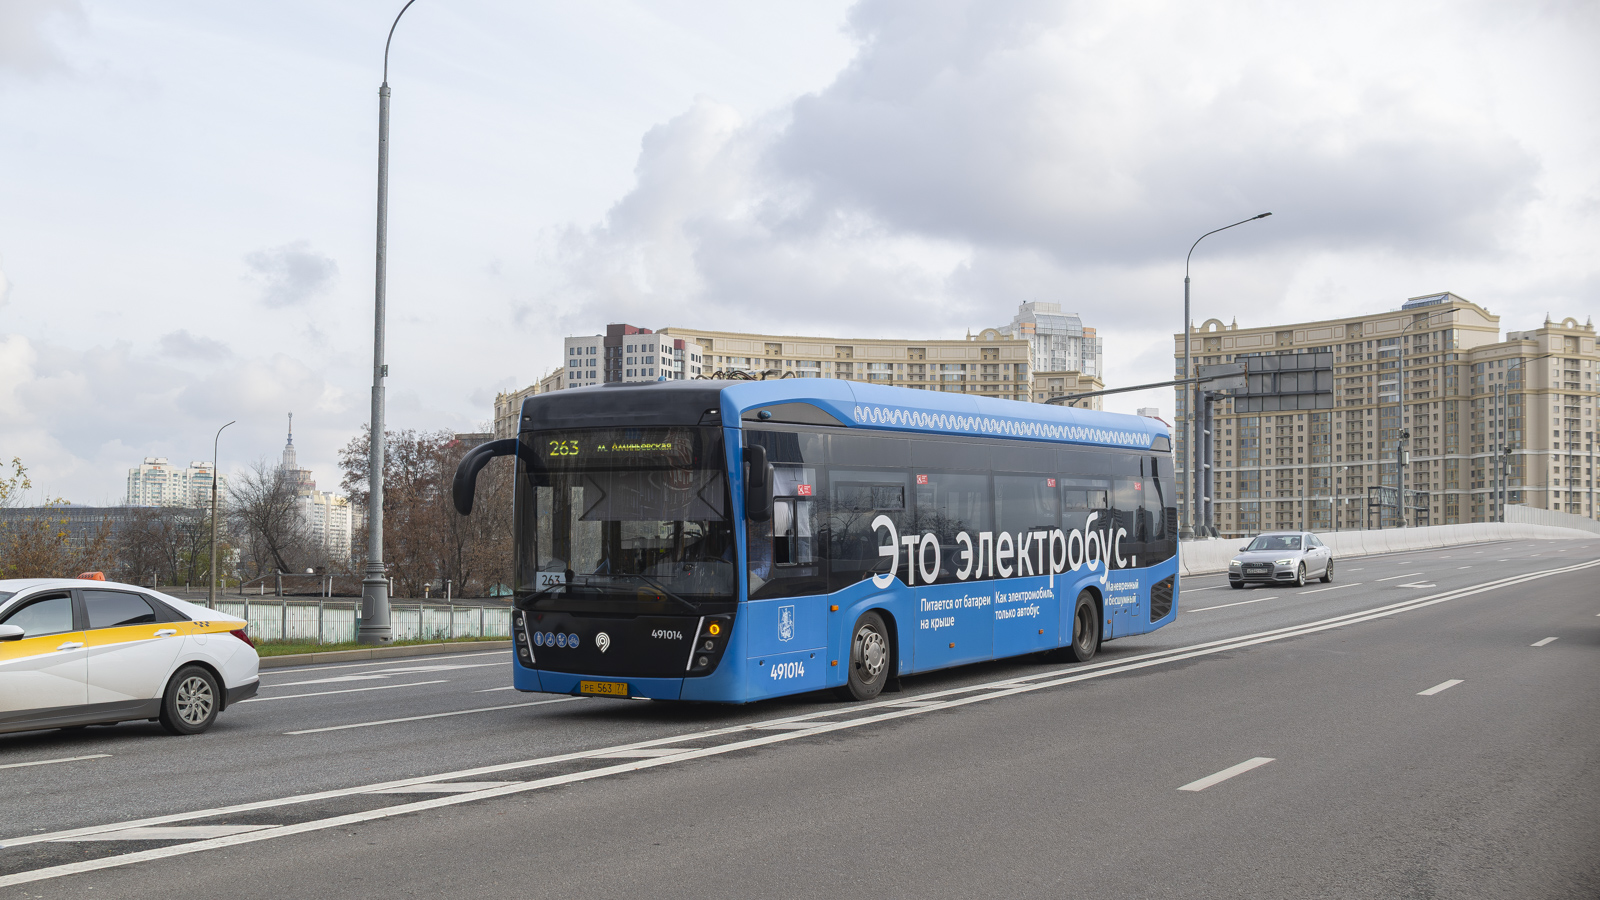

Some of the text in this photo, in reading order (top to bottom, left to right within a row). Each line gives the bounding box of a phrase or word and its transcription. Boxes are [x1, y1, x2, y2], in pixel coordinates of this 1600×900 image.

[549, 440, 579, 456] 263
[870, 511, 1137, 588] Это электробус.
[541, 574, 560, 586] 263
[920, 594, 991, 612] Питается от батареи
[995, 586, 1055, 604] Как электромобиль,
[995, 603, 1040, 620] только автобус
[920, 616, 955, 631] на крыше
[651, 629, 683, 641] 491014
[770, 661, 805, 681] 491014
[597, 682, 612, 694] 563
